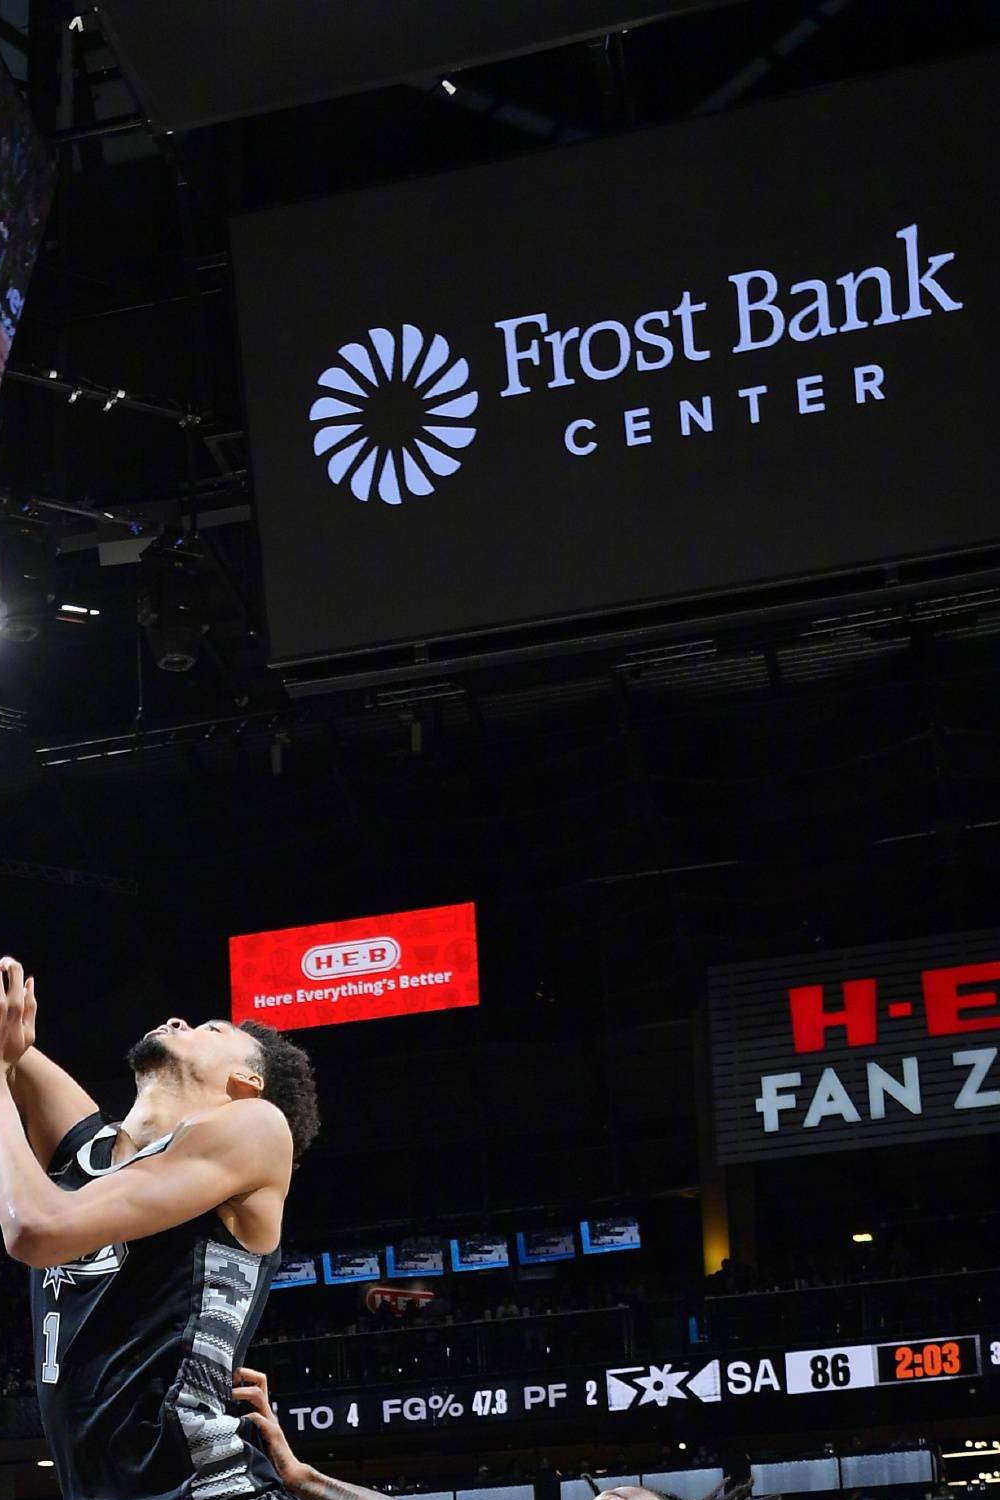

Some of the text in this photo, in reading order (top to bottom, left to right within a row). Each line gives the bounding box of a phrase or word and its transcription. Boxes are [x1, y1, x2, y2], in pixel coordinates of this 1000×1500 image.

[495, 224, 963, 398] Frost Bank
[564, 364, 887, 457] CENTER
[254, 971, 453, 1009] Here Everything's Better
[756, 1056, 922, 1133] FAN
[42, 1311, 61, 1385] 1
[727, 1358, 781, 1395] SA
[809, 1353, 851, 1389] 86
[894, 1341, 962, 1380] 2:03
[289, 1380, 598, 1431] TO 4 FG% 47.8 PF 2
